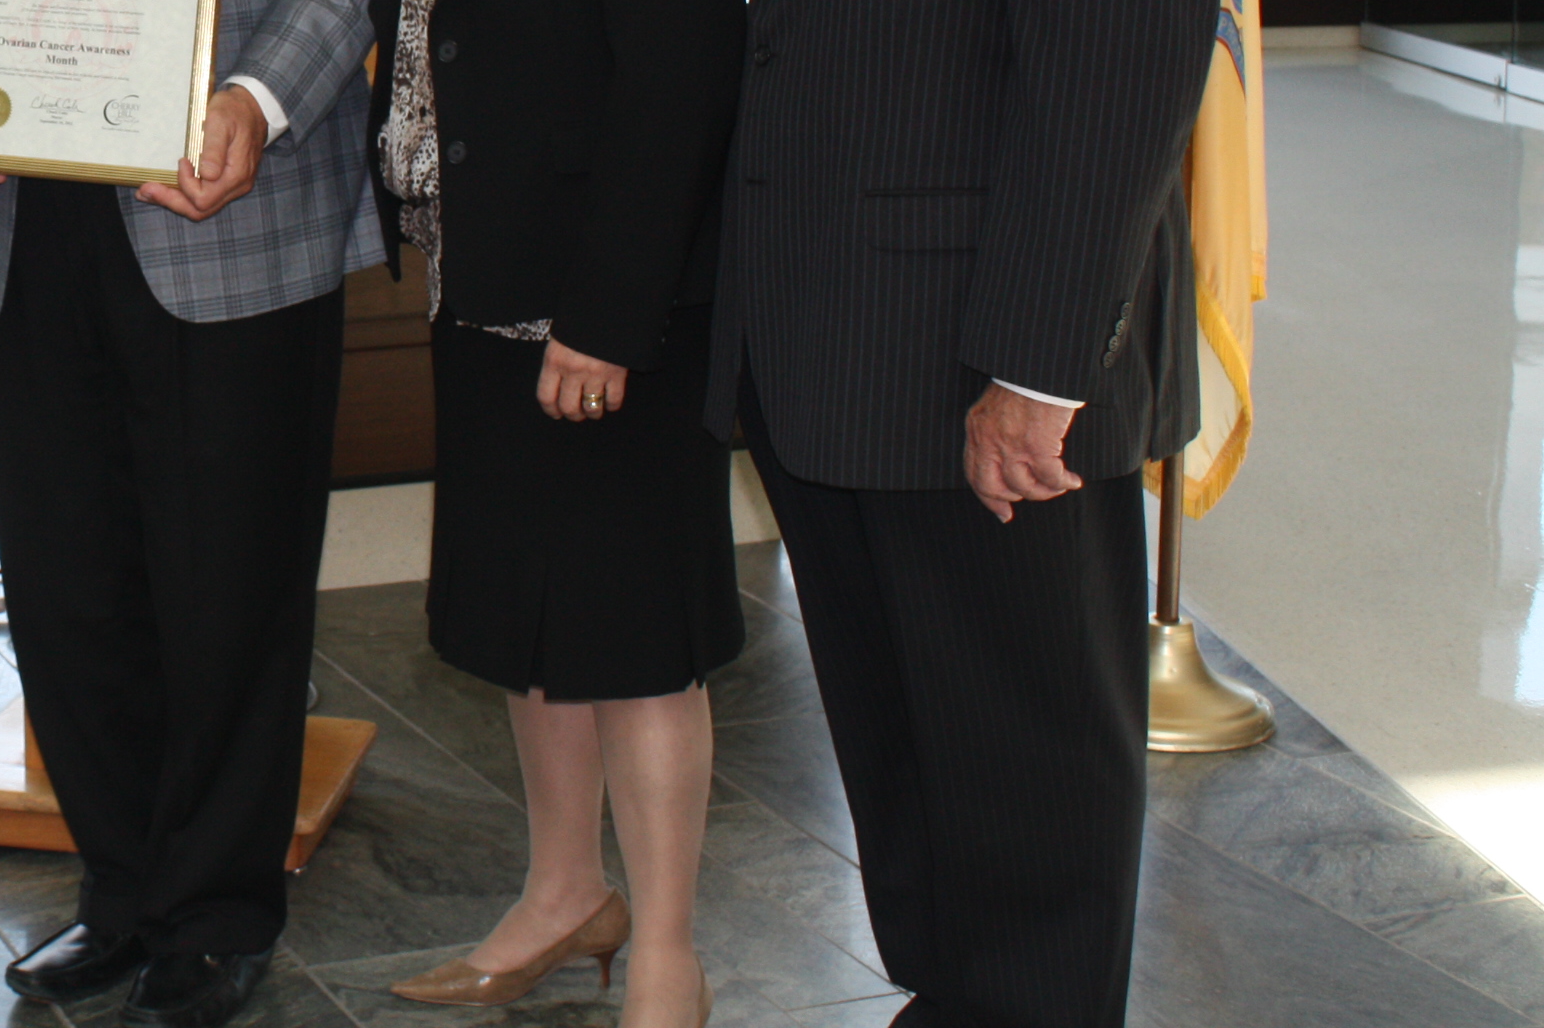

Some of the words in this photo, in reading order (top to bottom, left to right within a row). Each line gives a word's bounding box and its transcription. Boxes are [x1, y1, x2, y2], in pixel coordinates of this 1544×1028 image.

[39, 40, 74, 51] Cancer
[78, 44, 131, 56] Awareness
[45, 54, 78, 66] Month
